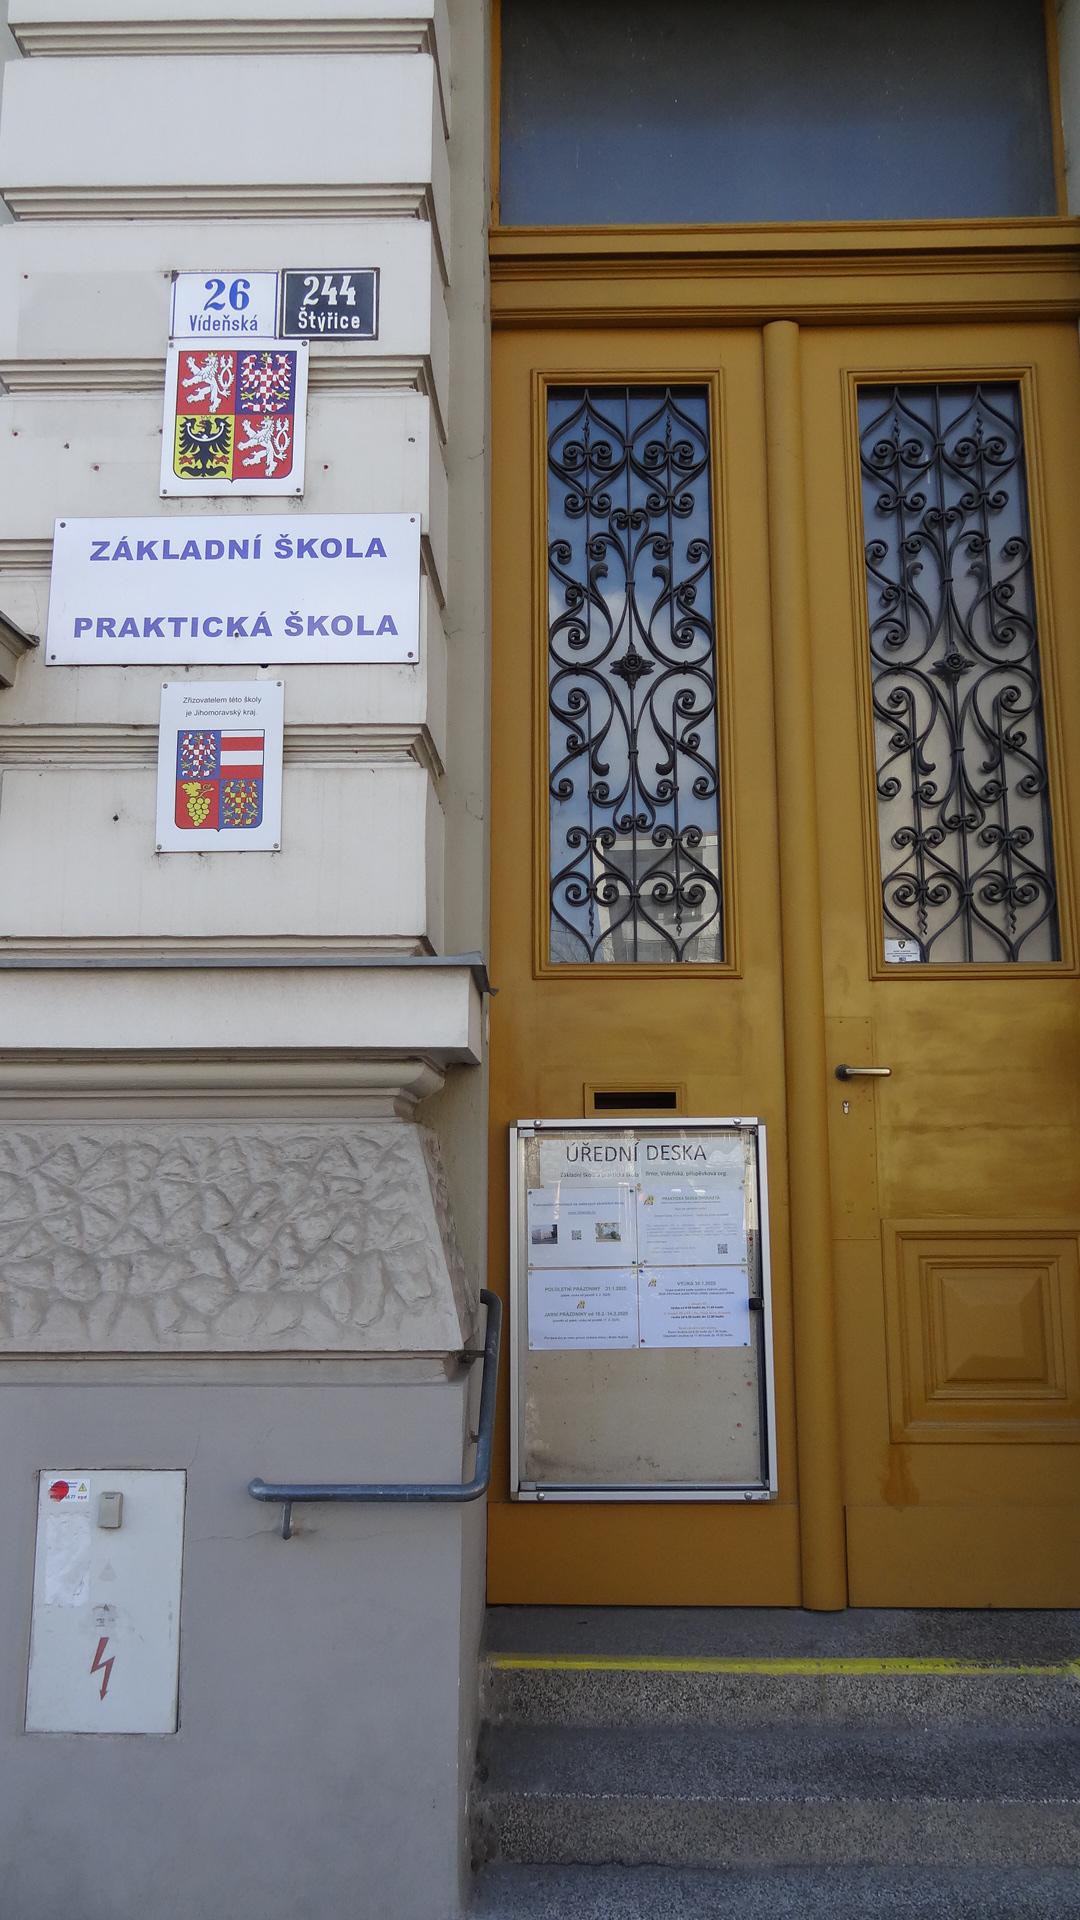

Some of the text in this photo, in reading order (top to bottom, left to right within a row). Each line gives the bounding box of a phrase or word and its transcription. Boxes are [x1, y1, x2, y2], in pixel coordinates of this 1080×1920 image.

[203, 278, 251, 311] 26
[303, 275, 356, 306] 244
[189, 314, 258, 332] Vídeňská
[298, 306, 361, 332] Štýřice
[89, 533, 388, 561] ZÁKLADNÍ ŠKOLA
[73, 610, 399, 638] PRAKTICKÁ ŠKOLA
[182, 696, 228, 704] Zřizovatelem
[243, 696, 262, 704] školy
[193, 709, 241, 717] Jihomoravský
[566, 1142, 707, 1162] ÚŘEDNÍ DESKA
